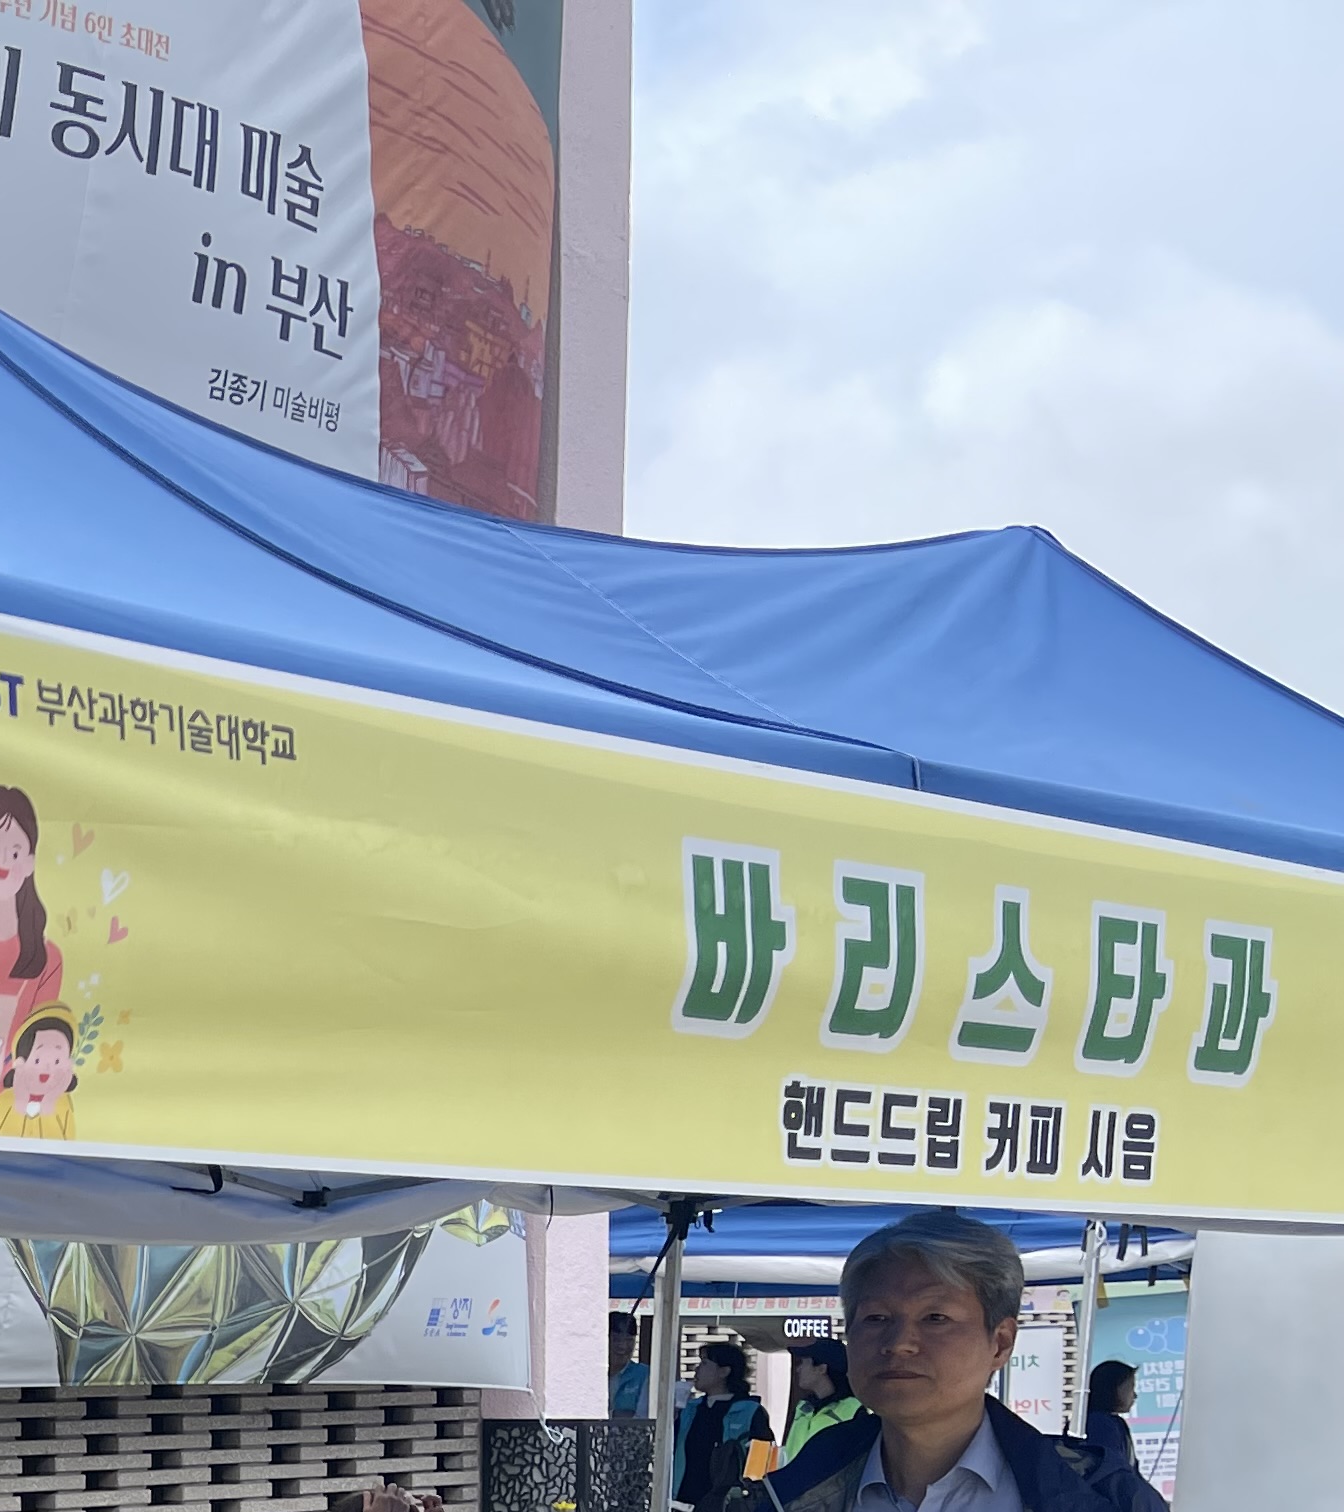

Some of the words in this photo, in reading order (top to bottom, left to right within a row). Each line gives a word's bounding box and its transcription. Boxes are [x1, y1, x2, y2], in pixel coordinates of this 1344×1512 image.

[39, 0, 78, 33] 기념
[84, 11, 113, 44] 6인
[118, 22, 171, 62] 초대전
[48, 60, 220, 193] 동시대
[238, 121, 325, 233] 미술
[191, 231, 247, 315] in
[265, 255, 355, 361] 부산
[208, 367, 268, 412] 김종기
[272, 386, 342, 433] 미술비평
[35, 678, 298, 766] 부산과학기술대학교
[678, 852, 1274, 1078] 바리스타과
[782, 1080, 963, 1170] 핸드드립
[986, 1101, 1063, 1176] 커피
[1081, 1109, 1158, 1181] 시음
[783, 1317, 829, 1338] COFFEE
